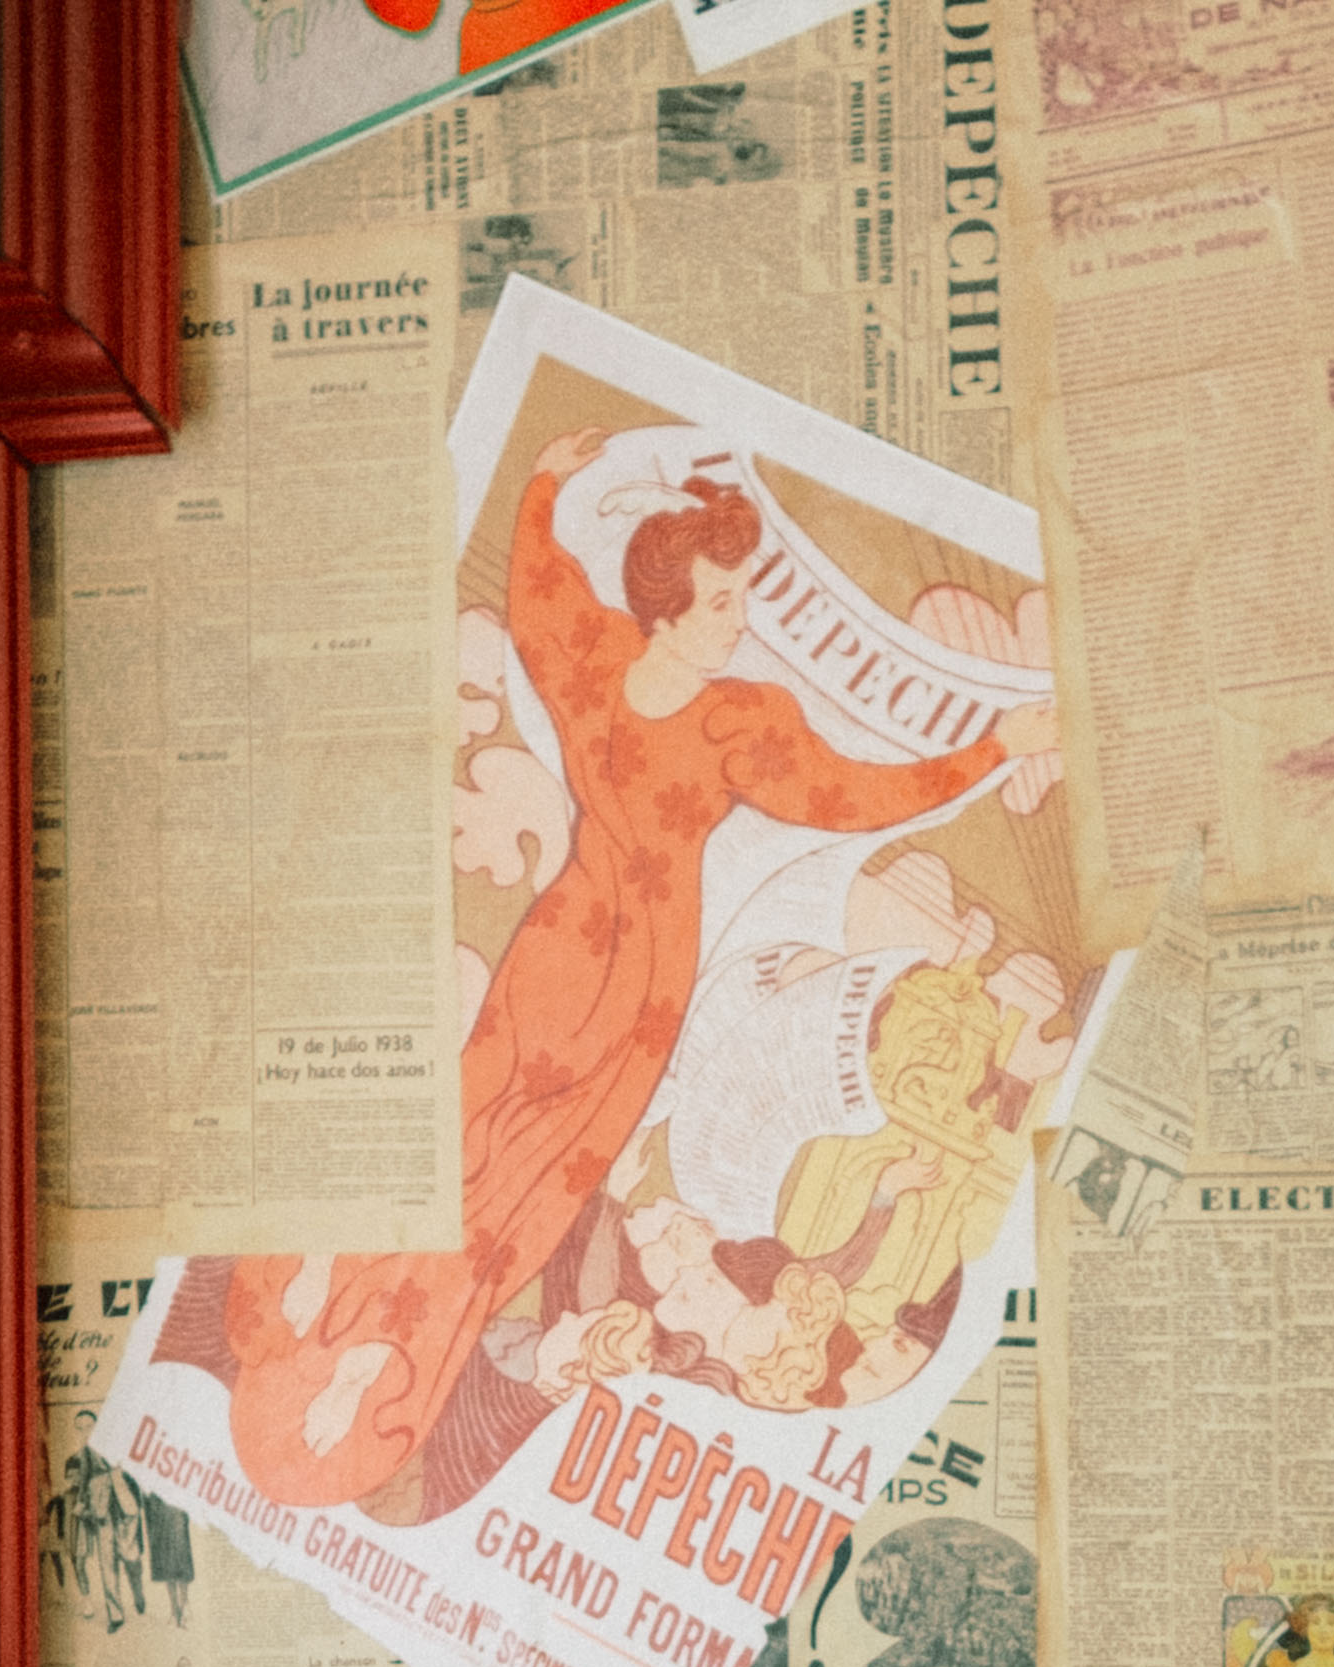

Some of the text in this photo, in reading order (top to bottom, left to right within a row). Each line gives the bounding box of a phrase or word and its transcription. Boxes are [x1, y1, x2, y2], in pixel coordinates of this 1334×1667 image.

[301, 271, 429, 311] journée
[303, 313, 429, 341] travers
[277, 1034, 414, 1059] 19 de Julio 1938
[307, 1062, 347, 1079] hace
[351, 1060, 380, 1078] dos
[807, 1424, 874, 1505] LA
[128, 1413, 298, 1545] Distribution
[303, 1513, 430, 1613] GRATUITE
[474, 1505, 620, 1621] GRAND
